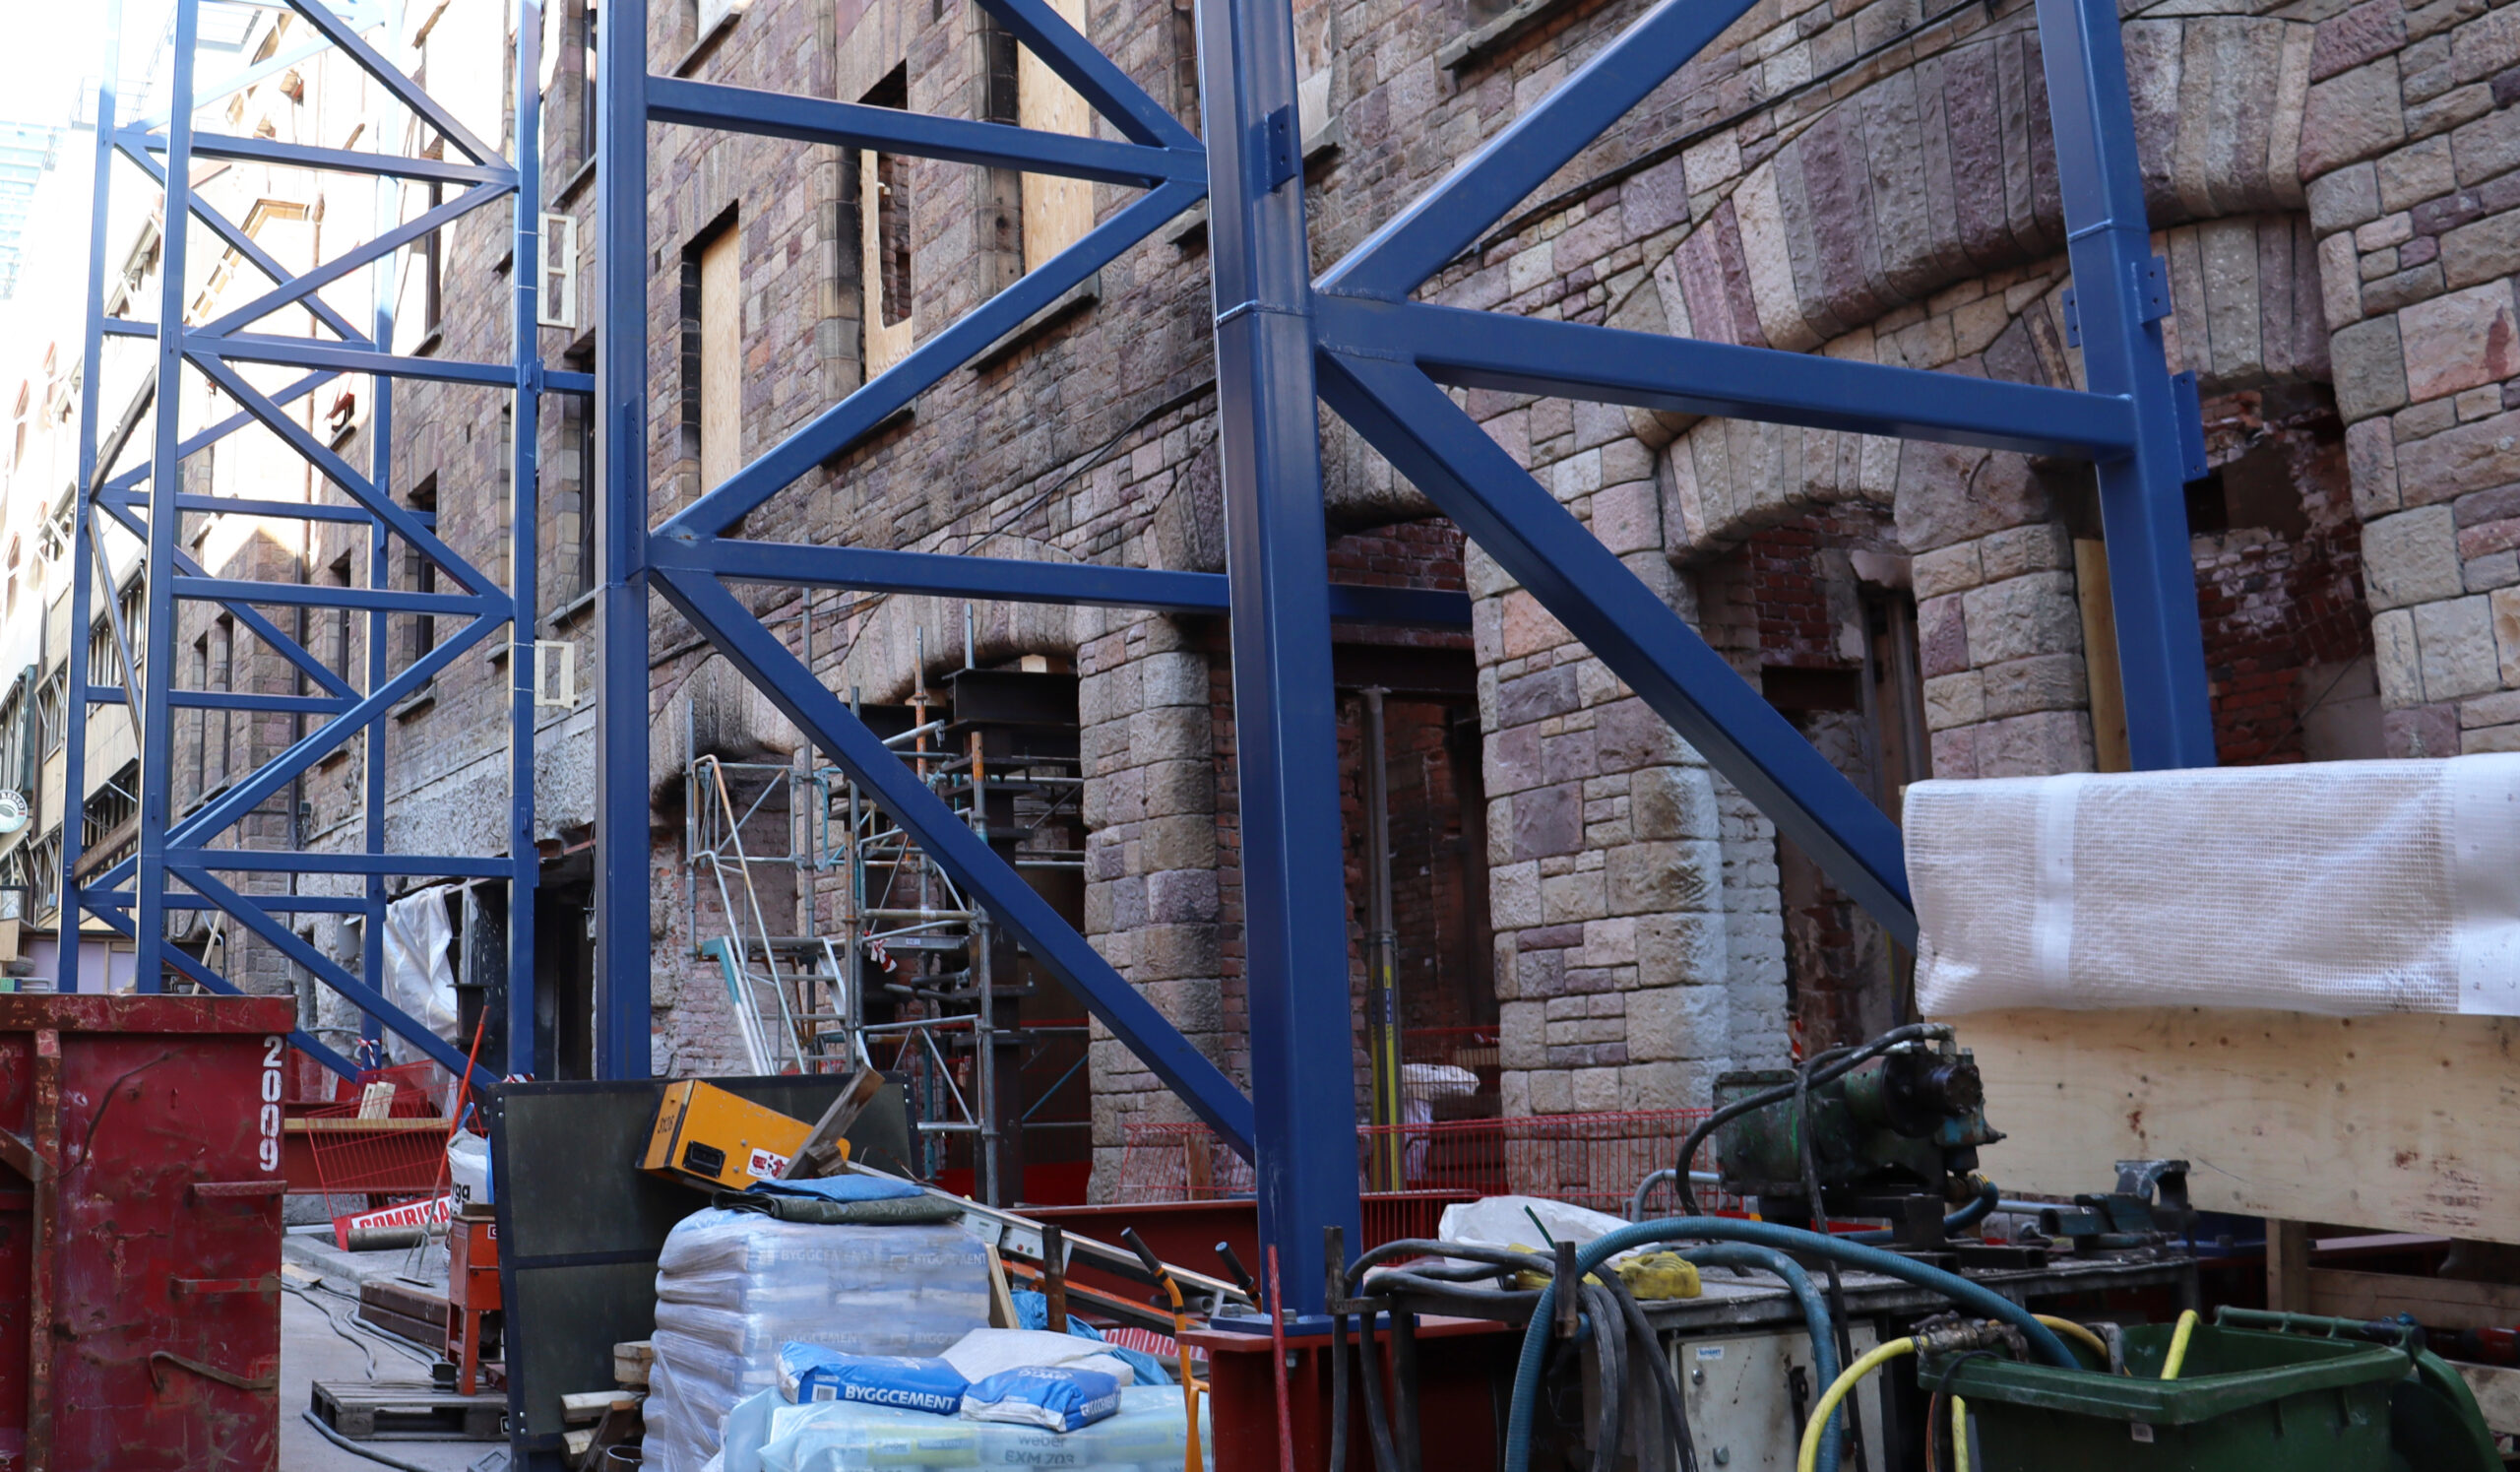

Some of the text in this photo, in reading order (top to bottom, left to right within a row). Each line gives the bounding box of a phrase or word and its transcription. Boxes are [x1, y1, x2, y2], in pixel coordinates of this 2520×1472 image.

[259, 1035, 284, 1172] 2009
[845, 1385, 956, 1410] BYGGCEMENT
[1005, 1449, 1041, 1464] EXM
